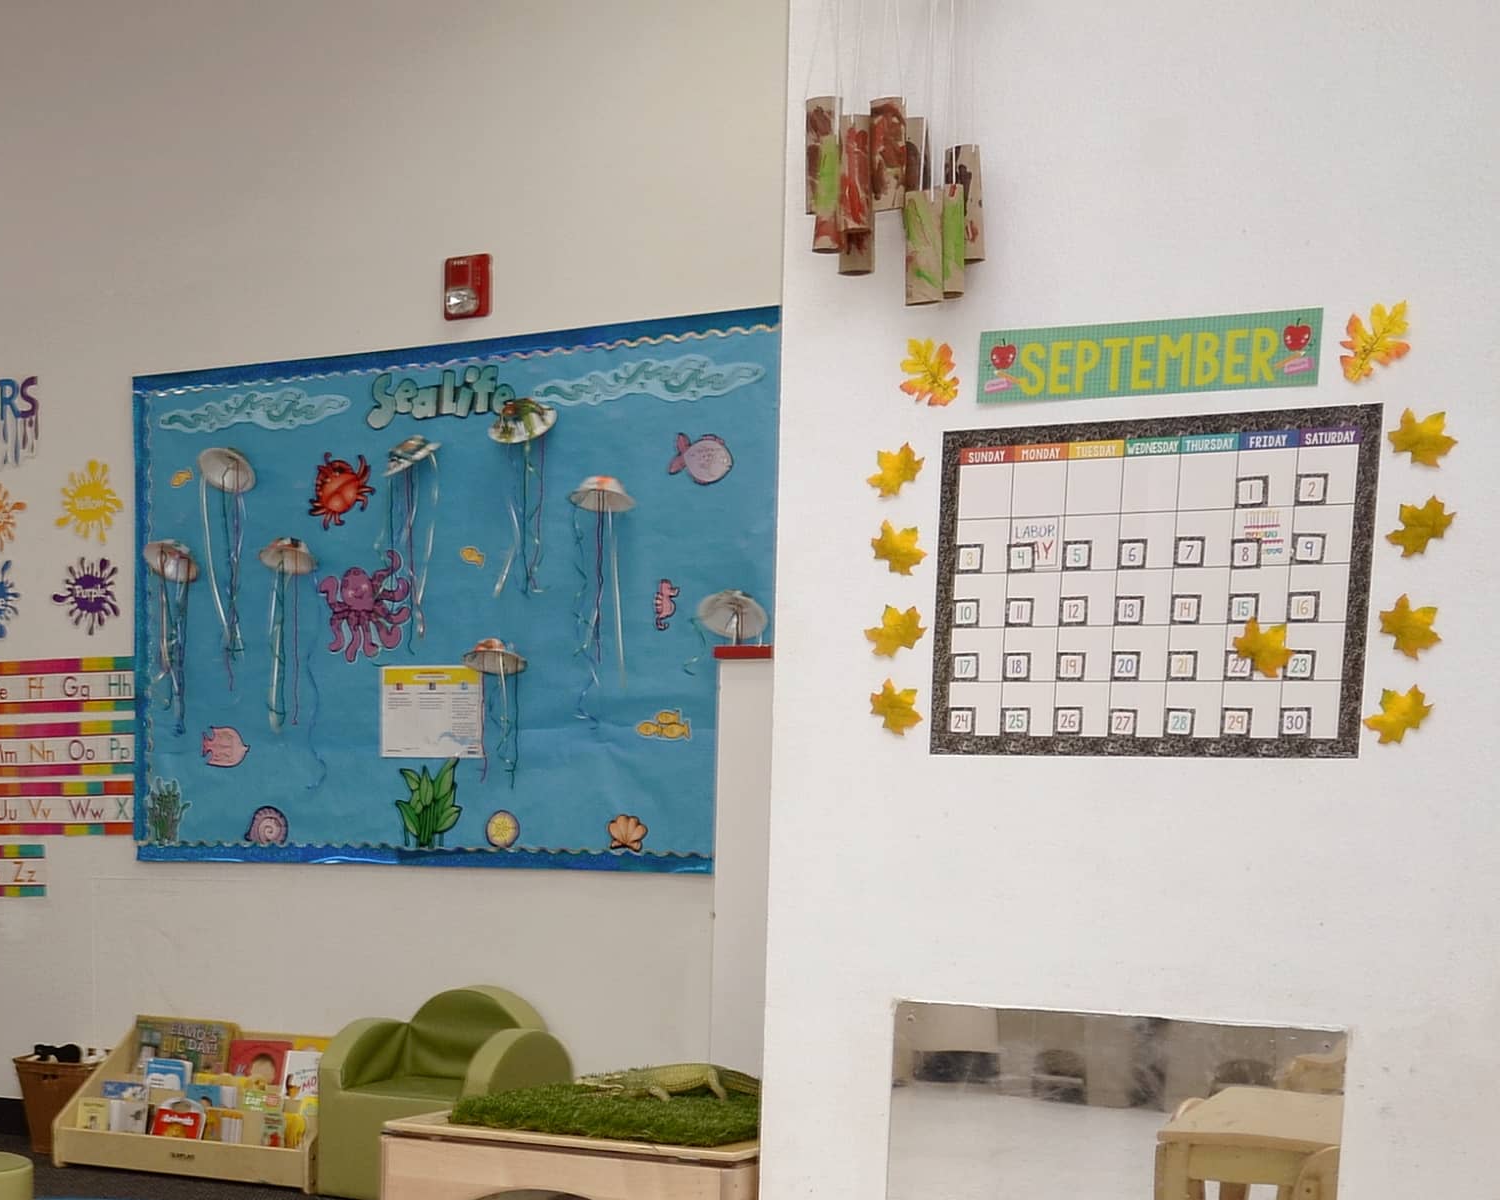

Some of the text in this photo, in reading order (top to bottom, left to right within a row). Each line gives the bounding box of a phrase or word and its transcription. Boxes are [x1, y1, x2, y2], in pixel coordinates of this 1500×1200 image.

[1020, 327, 1280, 396] SEPTEMBER
[968, 430, 1356, 463] SUNDAY MONDAY TUESDAY WEDNESDAY THURSDAY FRIDAY SATURDAY
[1308, 481, 1316, 497] 2
[1015, 524, 1055, 539] LABOR
[966, 541, 1313, 566] 3 4 5 6 7 8 9
[75, 586, 106, 602] Purple
[960, 600, 1308, 620] 10 11 12 13 14 15 16
[959, 657, 1307, 674] 17 18 19 20 21 22 23
[28, 677, 45, 699] Ff
[62, 676, 90, 699] Gg
[108, 674, 132, 697] Hh
[954, 713, 1303, 731] 24 25 26 27 28 29 30
[29, 743, 56, 763] Nn
[68, 740, 95, 761] Oo
[110, 738, 130, 761] Pp
[28, 800, 51, 820] Vv
[68, 800, 104, 820] Ww
[116, 797, 130, 820] X
[13, 861, 37, 883] Zz
